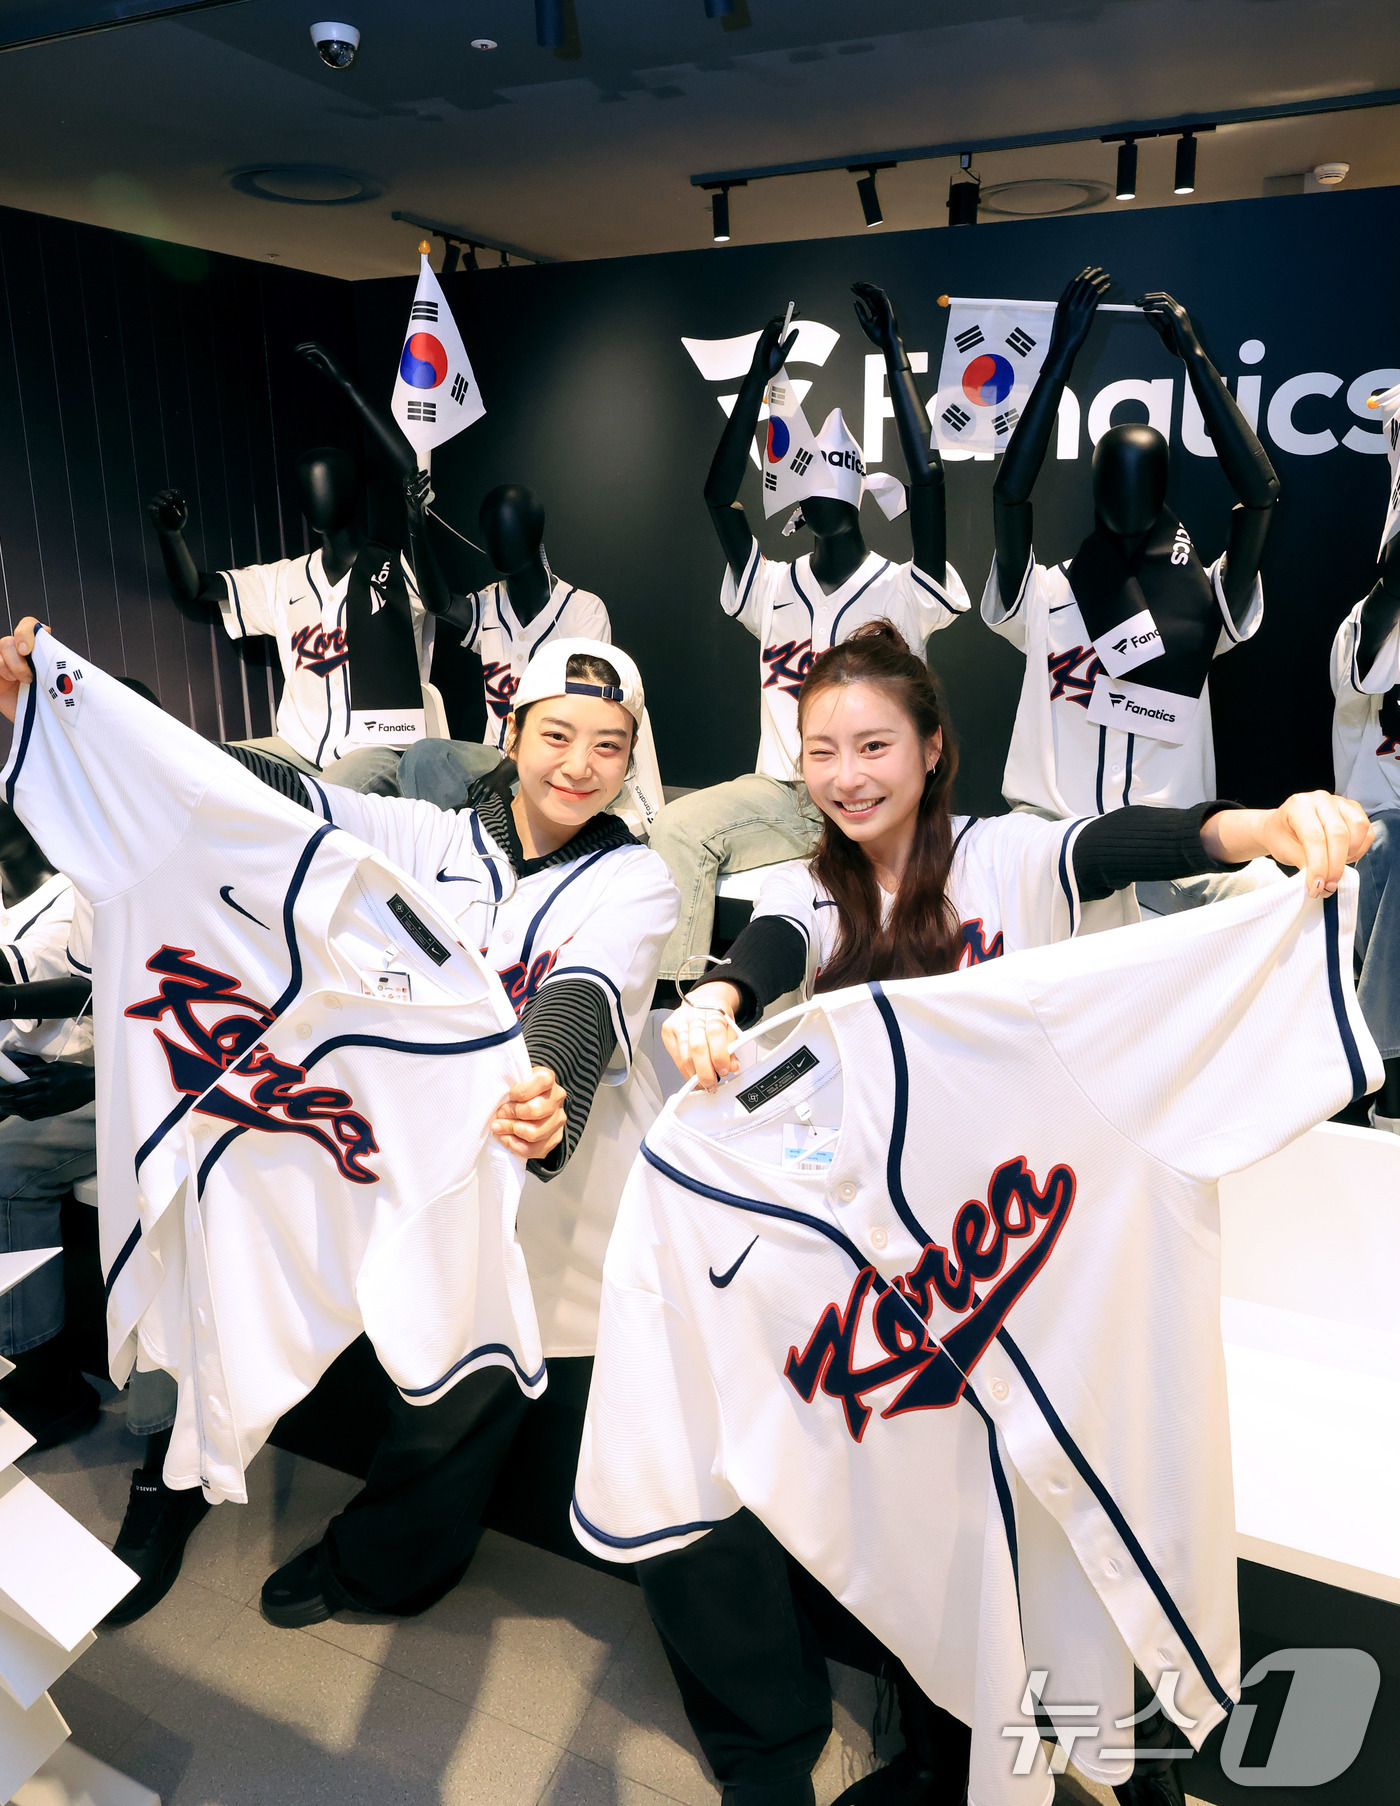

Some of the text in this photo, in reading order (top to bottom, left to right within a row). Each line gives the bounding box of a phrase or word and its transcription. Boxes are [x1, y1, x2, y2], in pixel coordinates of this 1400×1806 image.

[378, 723, 416, 732] Fanatics
[1125, 700, 1176, 723] Fanatics
[124, 944, 380, 1184] Korea
[784, 1155, 1077, 1443] Korea
